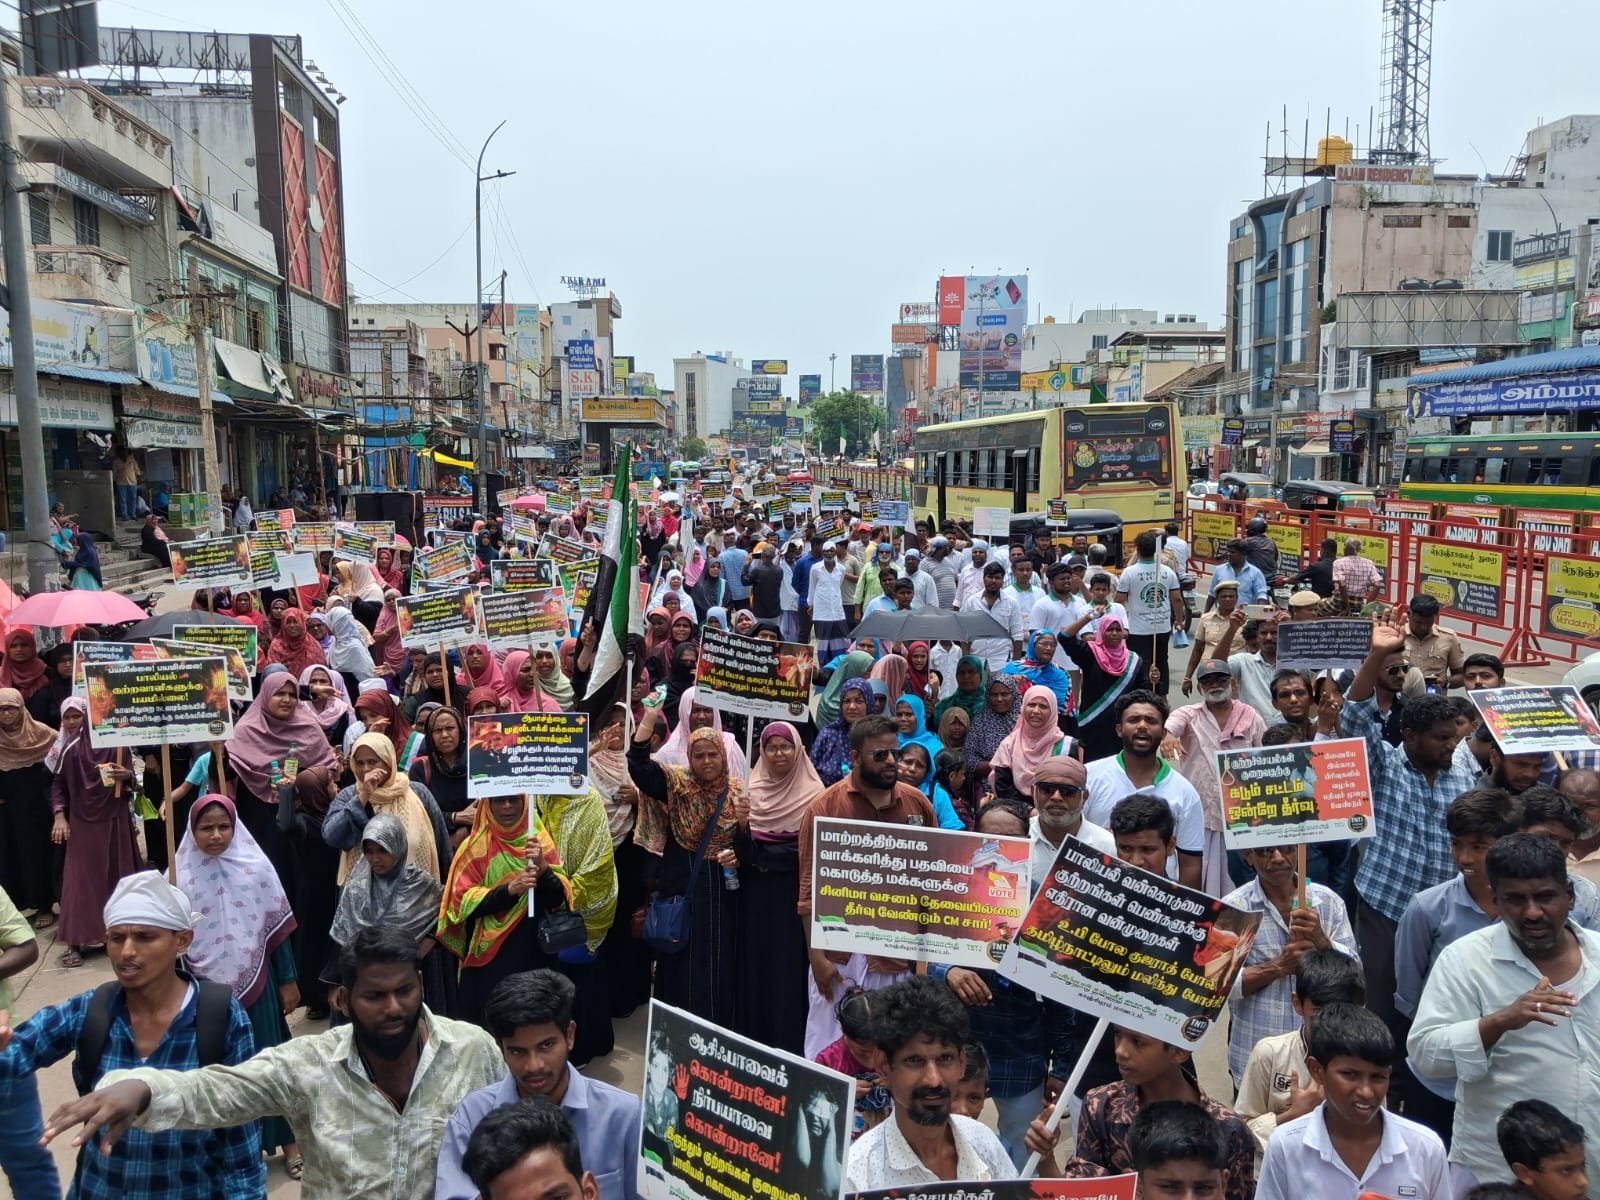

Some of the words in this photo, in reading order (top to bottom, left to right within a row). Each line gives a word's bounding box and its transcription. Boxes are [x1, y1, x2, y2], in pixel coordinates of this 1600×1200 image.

[1367, 167, 1414, 182] RESIDENCY
[1514, 239, 1544, 259] GAMMA
[1545, 233, 1570, 253] PONT
[571, 371, 592, 383] S.K
[1430, 546, 1475, 561] நெடுஞ்சாலைத்
[1478, 554, 1497, 565] துறை
[1558, 608, 1572, 617] Vara
[112, 683, 204, 696] குற்றவாளிகளுக்கு
[136, 672, 178, 683] பாலியல்
[132, 692, 189, 704] பயமில்லை!
[522, 714, 567, 724] ஆபாசத்தை
[511, 766, 575, 774] புறக்கணிப்போம்!
[545, 755, 578, 765] கொண்டு
[1231, 752, 1295, 769] குற்றச்செயல்கள்
[1241, 766, 1291, 780] குறைவதற்கு
[1230, 782, 1261, 800] கடும்
[1265, 778, 1304, 794] சட்டம்
[1228, 802, 1277, 820] ஒன்றே
[1282, 797, 1315, 817] தீர்வு
[820, 830, 928, 852] மாற்றத்திற்காக
[820, 849, 907, 870] வாக்களித்து
[909, 861, 975, 875] பதவியை
[820, 867, 883, 884] கொடுத்த
[886, 874, 969, 894] மக்களுக்கு
[1065, 848, 1121, 883] பாலியல்
[1121, 876, 1205, 917] வன்கொடுமை
[820, 885, 867, 899] சினிமா
[869, 892, 918, 906] வசனம்
[920, 897, 1020, 918] தேவையில்லை
[989, 889, 1014, 898] VOTE
[1055, 867, 1126, 909] குற்றங்கள்
[1127, 901, 1207, 942] பெண்களுக்கு
[845, 901, 875, 919] தீர்வு
[877, 908, 941, 925] வேண்டும்
[944, 915, 959, 926] CM
[962, 917, 992, 930] சார்!
[1045, 887, 1096, 918] எதிரான
[1097, 910, 1181, 952] வன்முறைகள்
[1057, 919, 1087, 939] உ.பி
[1088, 933, 1129, 958] போல
[1129, 951, 1179, 976] குஜராத்
[1026, 925, 1130, 976] தமிழ்நாட்டிலும்
[1130, 969, 1178, 997] மலிந்து
[689, 1032, 789, 1088] ஆசிஃபாவைக்
[690, 1059, 786, 1117] கொன்றானே!
[692, 1087, 773, 1140] நிர்பயாவை
[684, 1112, 782, 1174] கொன்றானே!
[672, 1155, 705, 1182] பாலியல்
[703, 1152, 751, 1184] குற்றங்கள்
